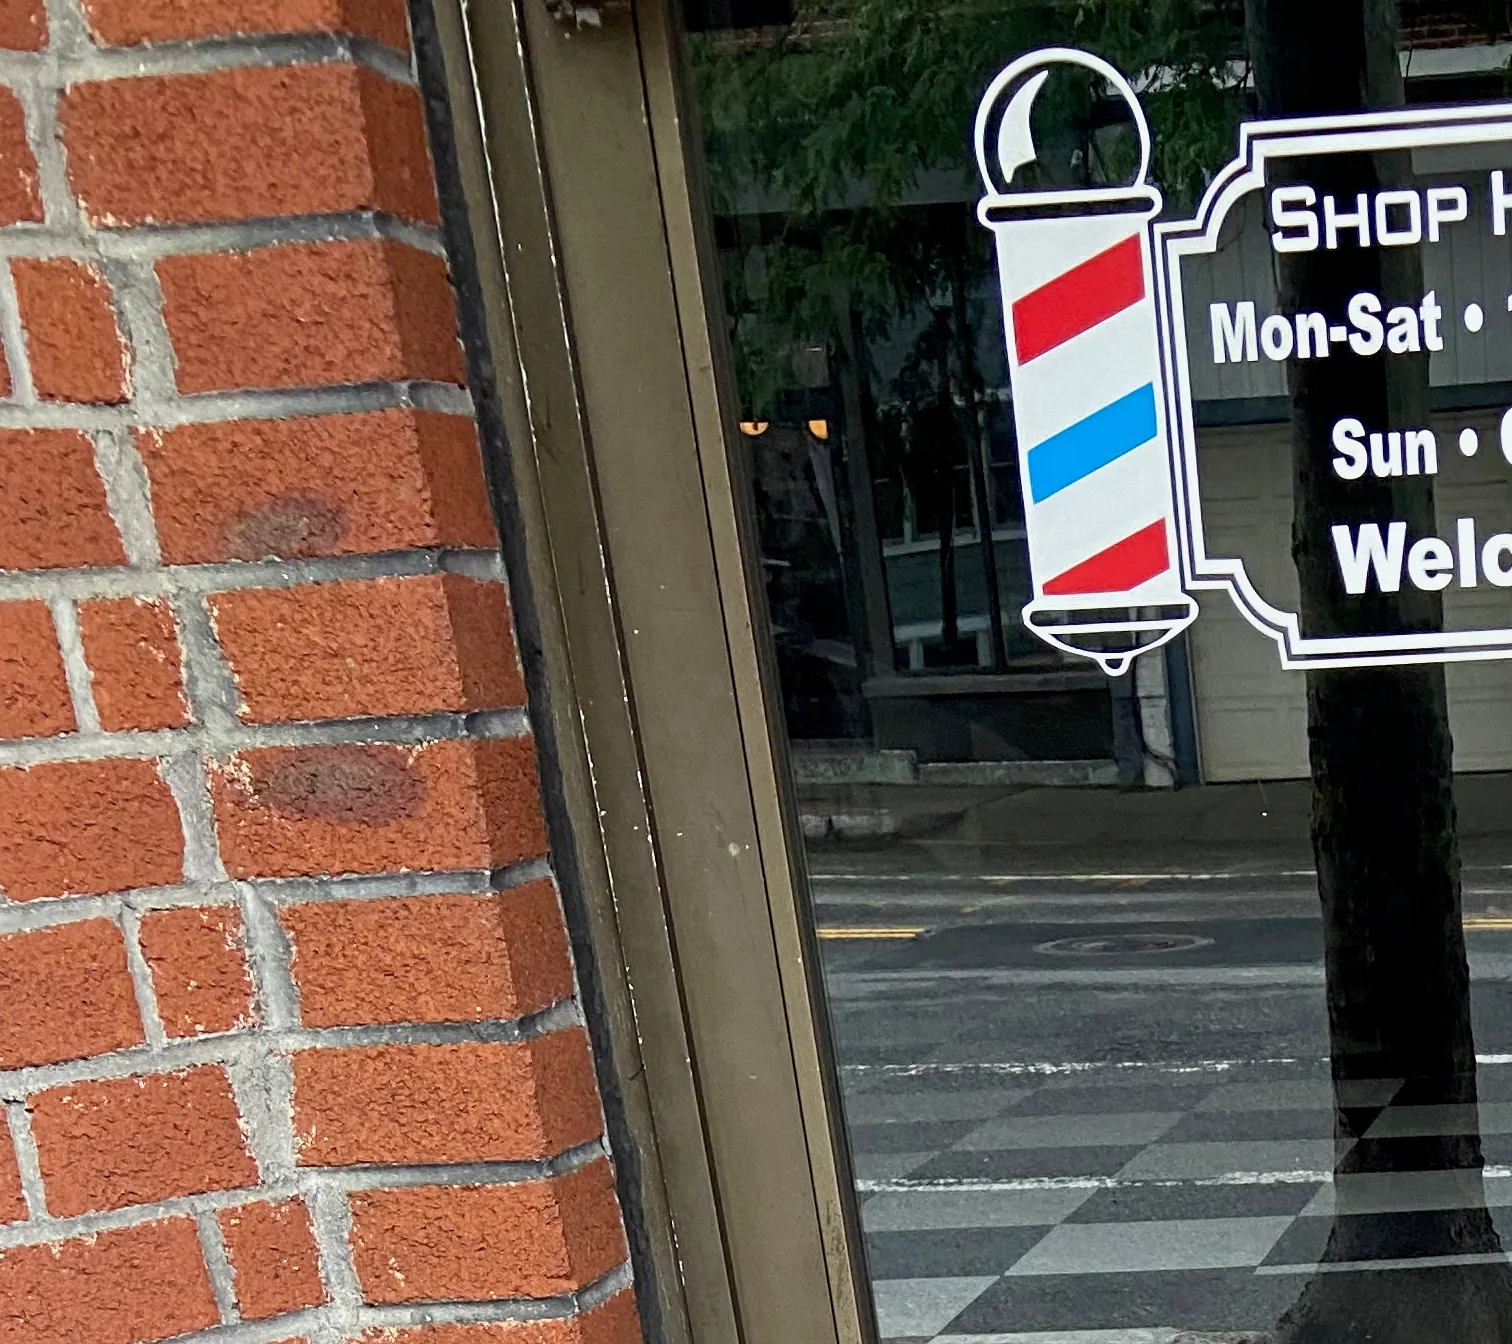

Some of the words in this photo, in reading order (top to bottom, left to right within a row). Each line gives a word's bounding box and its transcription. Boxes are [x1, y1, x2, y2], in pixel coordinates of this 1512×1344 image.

[1271, 186, 1468, 253] SHOP
[1209, 290, 1444, 364] Mon-Sat
[1332, 418, 1438, 480] Sun
